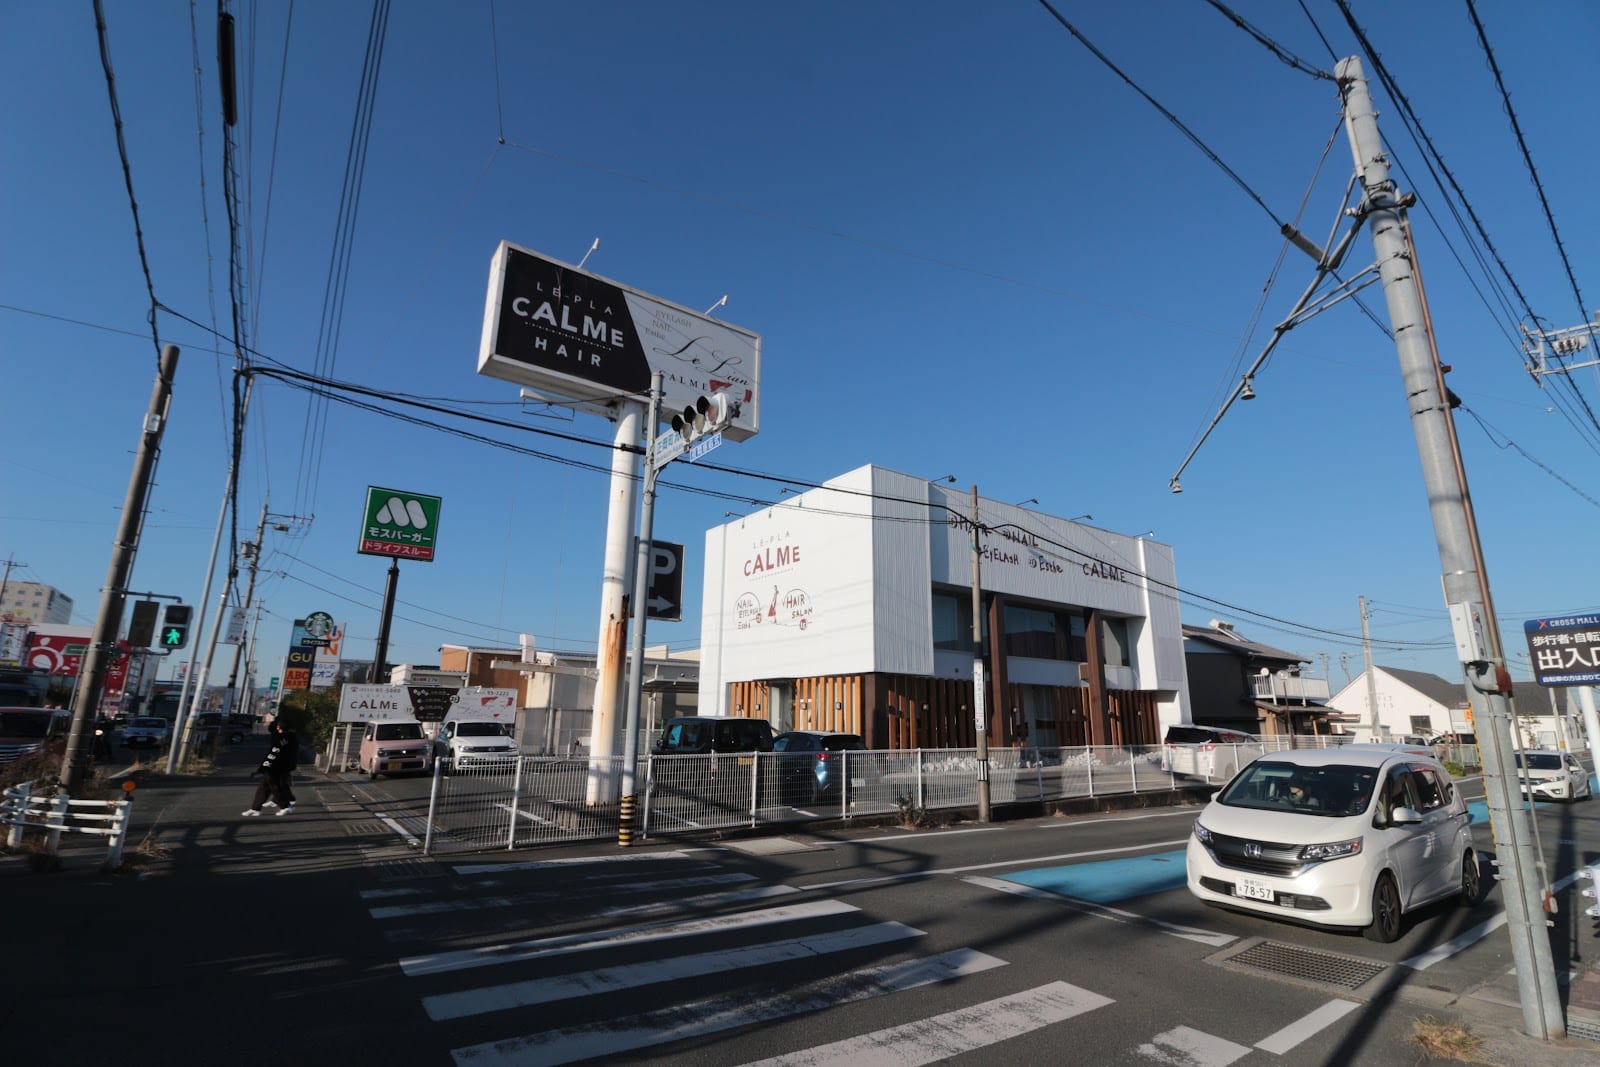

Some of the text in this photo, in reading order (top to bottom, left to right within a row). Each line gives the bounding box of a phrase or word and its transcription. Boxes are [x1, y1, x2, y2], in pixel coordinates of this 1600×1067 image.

[536, 281, 612, 315] LE-PLA
[512, 297, 624, 348] CALME
[652, 320, 671, 333] NAIL
[655, 310, 692, 328] EYELASH
[535, 336, 601, 367] HAIR
[368, 527, 432, 543] モスバーガー
[364, 541, 430, 555] ドライブスルー
[648, 547, 677, 588] P
[744, 546, 801, 577] CALME
[1083, 561, 1127, 583] CALME
[737, 599, 753, 610] NAIL
[786, 593, 805, 609] HAIR
[792, 606, 813, 619] SALON
[1550, 617, 1599, 628] CROSS MALL
[1532, 631, 1600, 647] 歩行者・自転
[290, 652, 312, 663] GU
[287, 670, 308, 680] ABC
[284, 680, 307, 689] MART
[350, 699, 398, 710] CALME
[1244, 885, 1271, 899] 78-57
